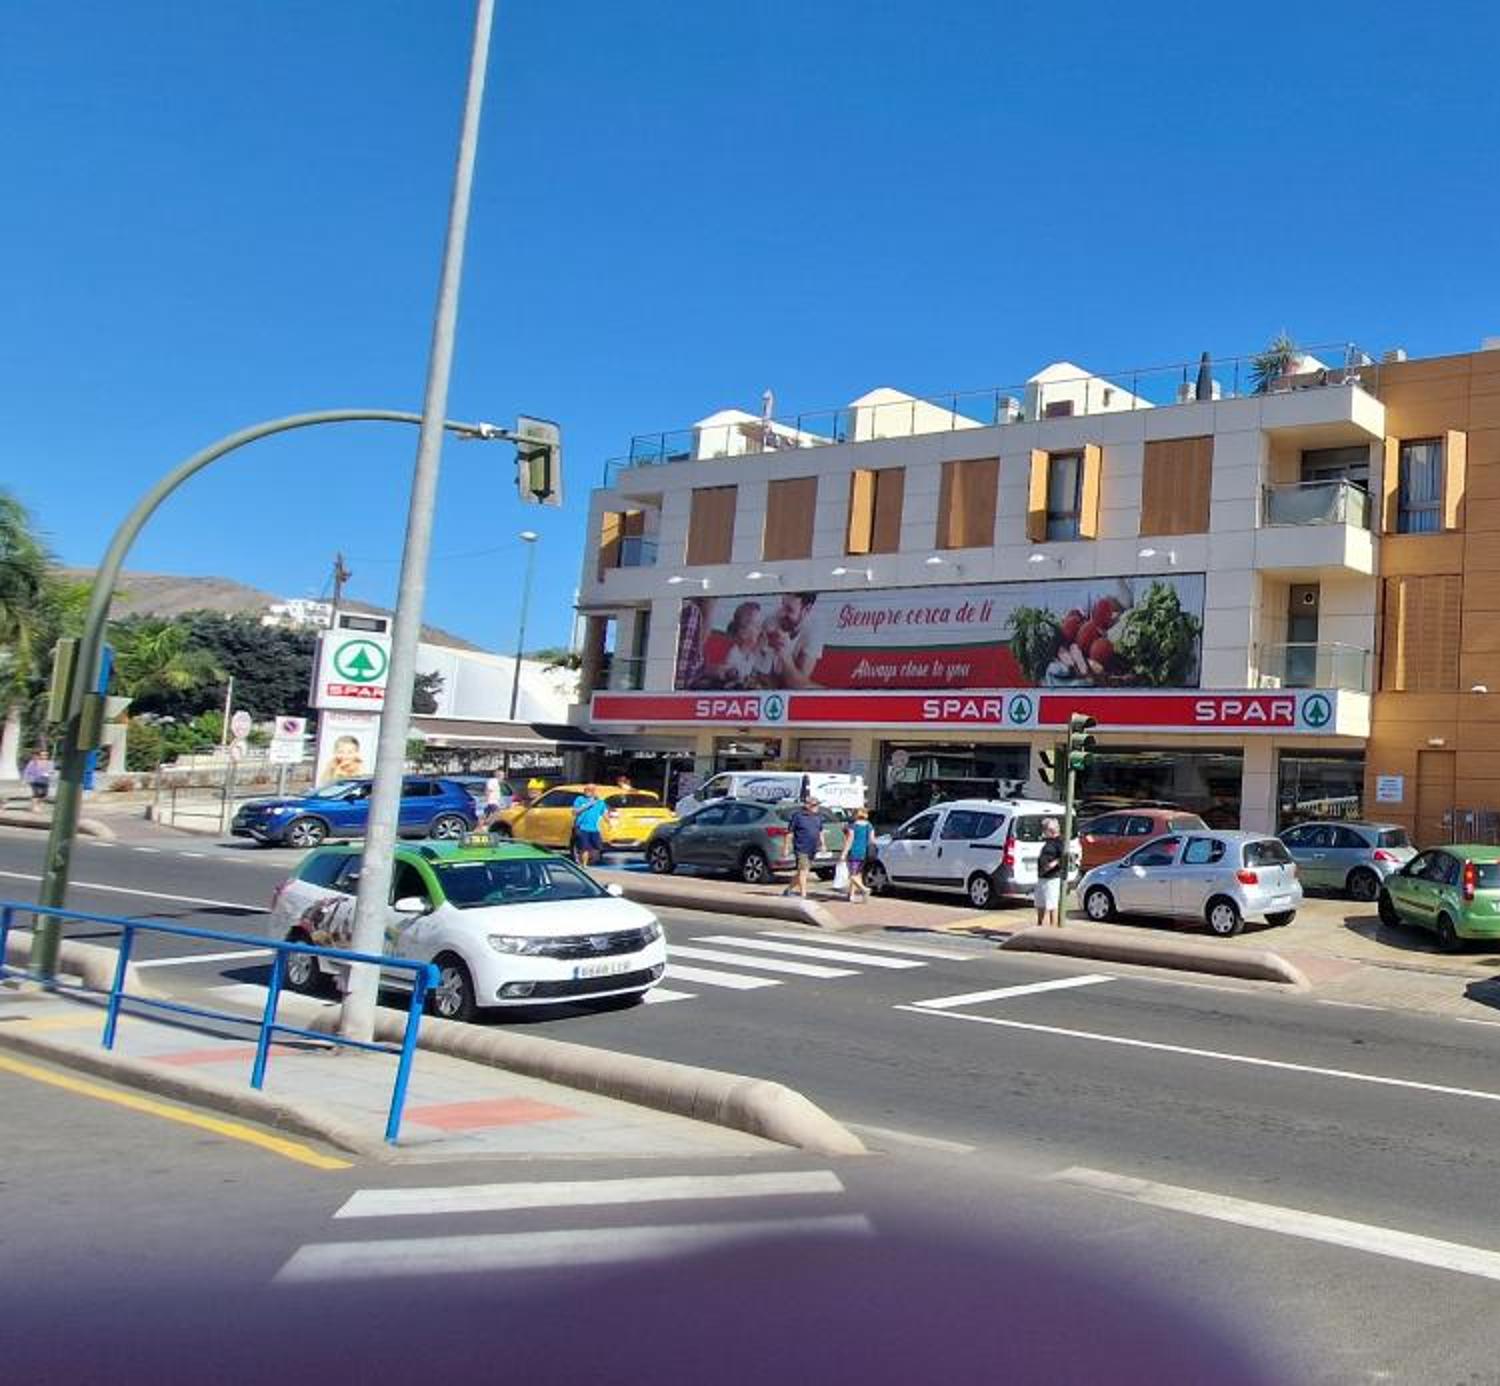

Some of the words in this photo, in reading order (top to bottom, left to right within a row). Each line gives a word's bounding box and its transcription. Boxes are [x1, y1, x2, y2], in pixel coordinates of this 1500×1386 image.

[838, 603, 902, 633] Siempre
[905, 607, 950, 625] cerca
[955, 601, 976, 624] de
[851, 658, 897, 681] Always
[900, 659, 929, 677] close
[946, 663, 972, 681] you
[695, 699, 759, 718] SPAR
[922, 699, 1002, 719] SPAR
[1195, 700, 1293, 721] SPAR
